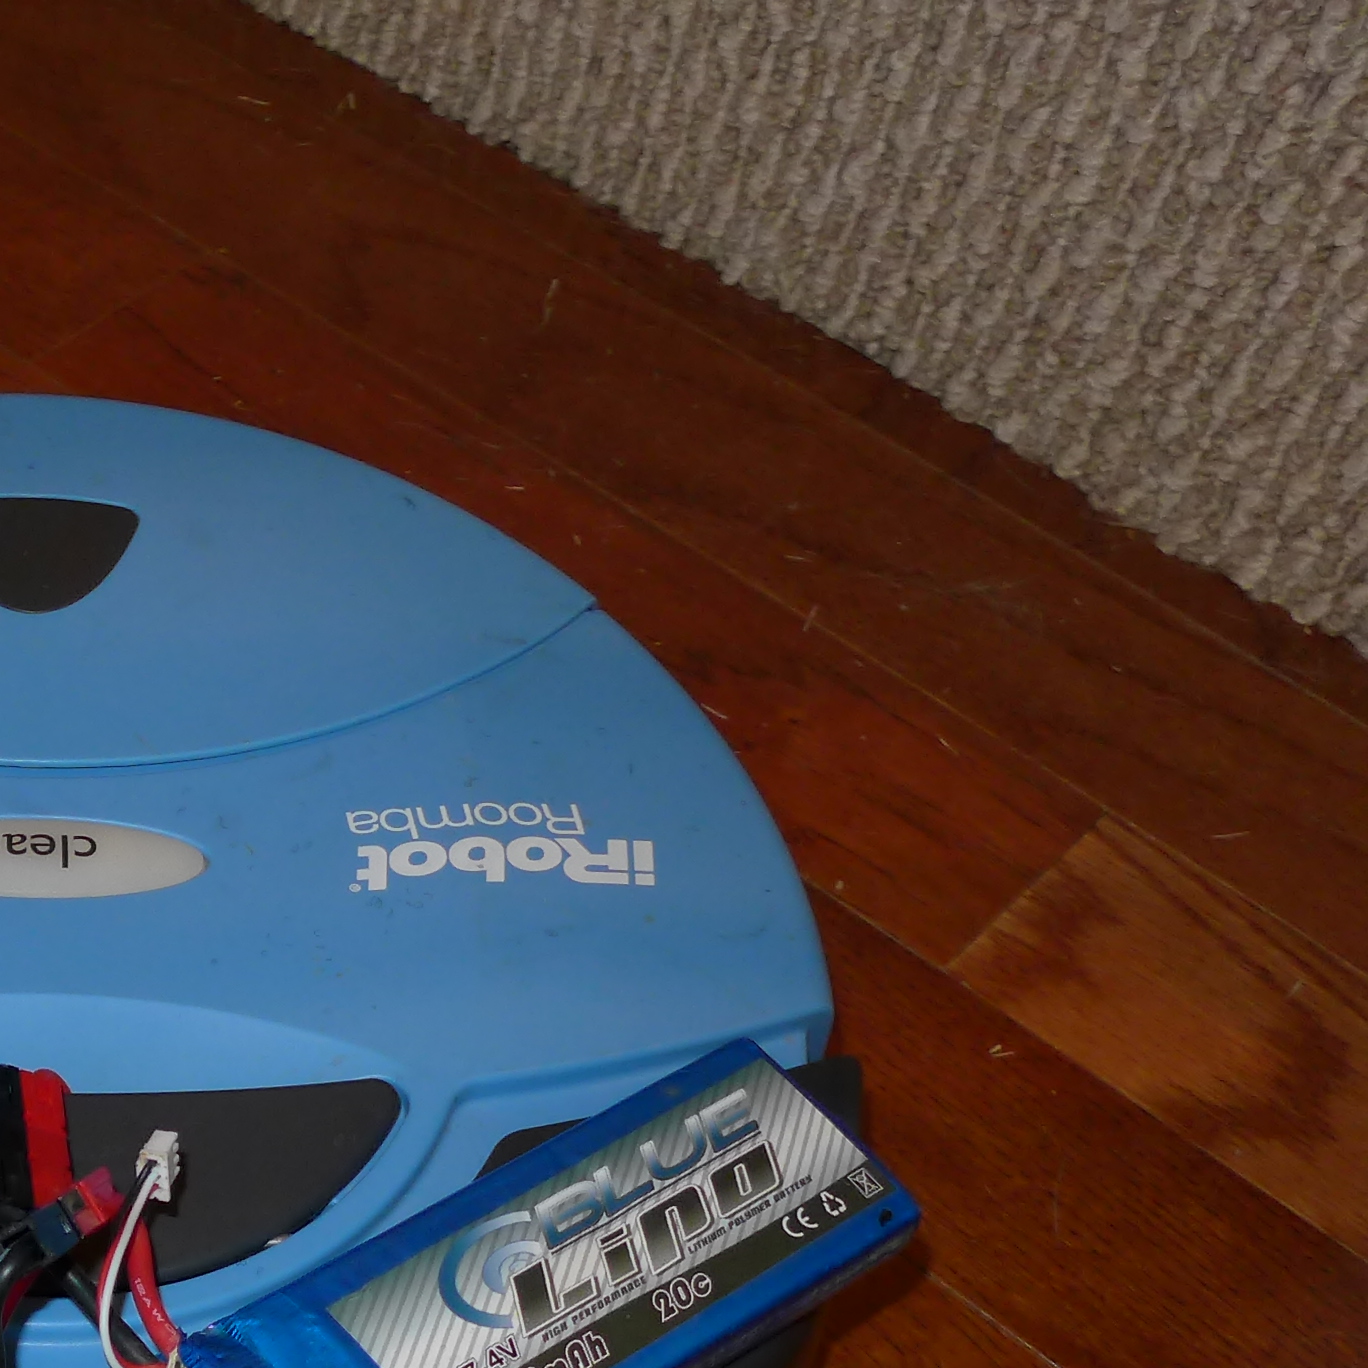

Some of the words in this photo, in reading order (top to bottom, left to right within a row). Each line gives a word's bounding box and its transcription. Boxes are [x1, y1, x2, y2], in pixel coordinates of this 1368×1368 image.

[345, 802, 585, 840] Roomba
[354, 836, 656, 891] iRobot
[534, 1088, 760, 1250] BLUE
[687, 1228, 727, 1255] LITHIUM
[728, 1200, 772, 1229] POLYMER
[773, 1174, 813, 1206] BATTERY
[541, 1321, 569, 1343] HIGH
[572, 1275, 648, 1325] PERFORMANCE
